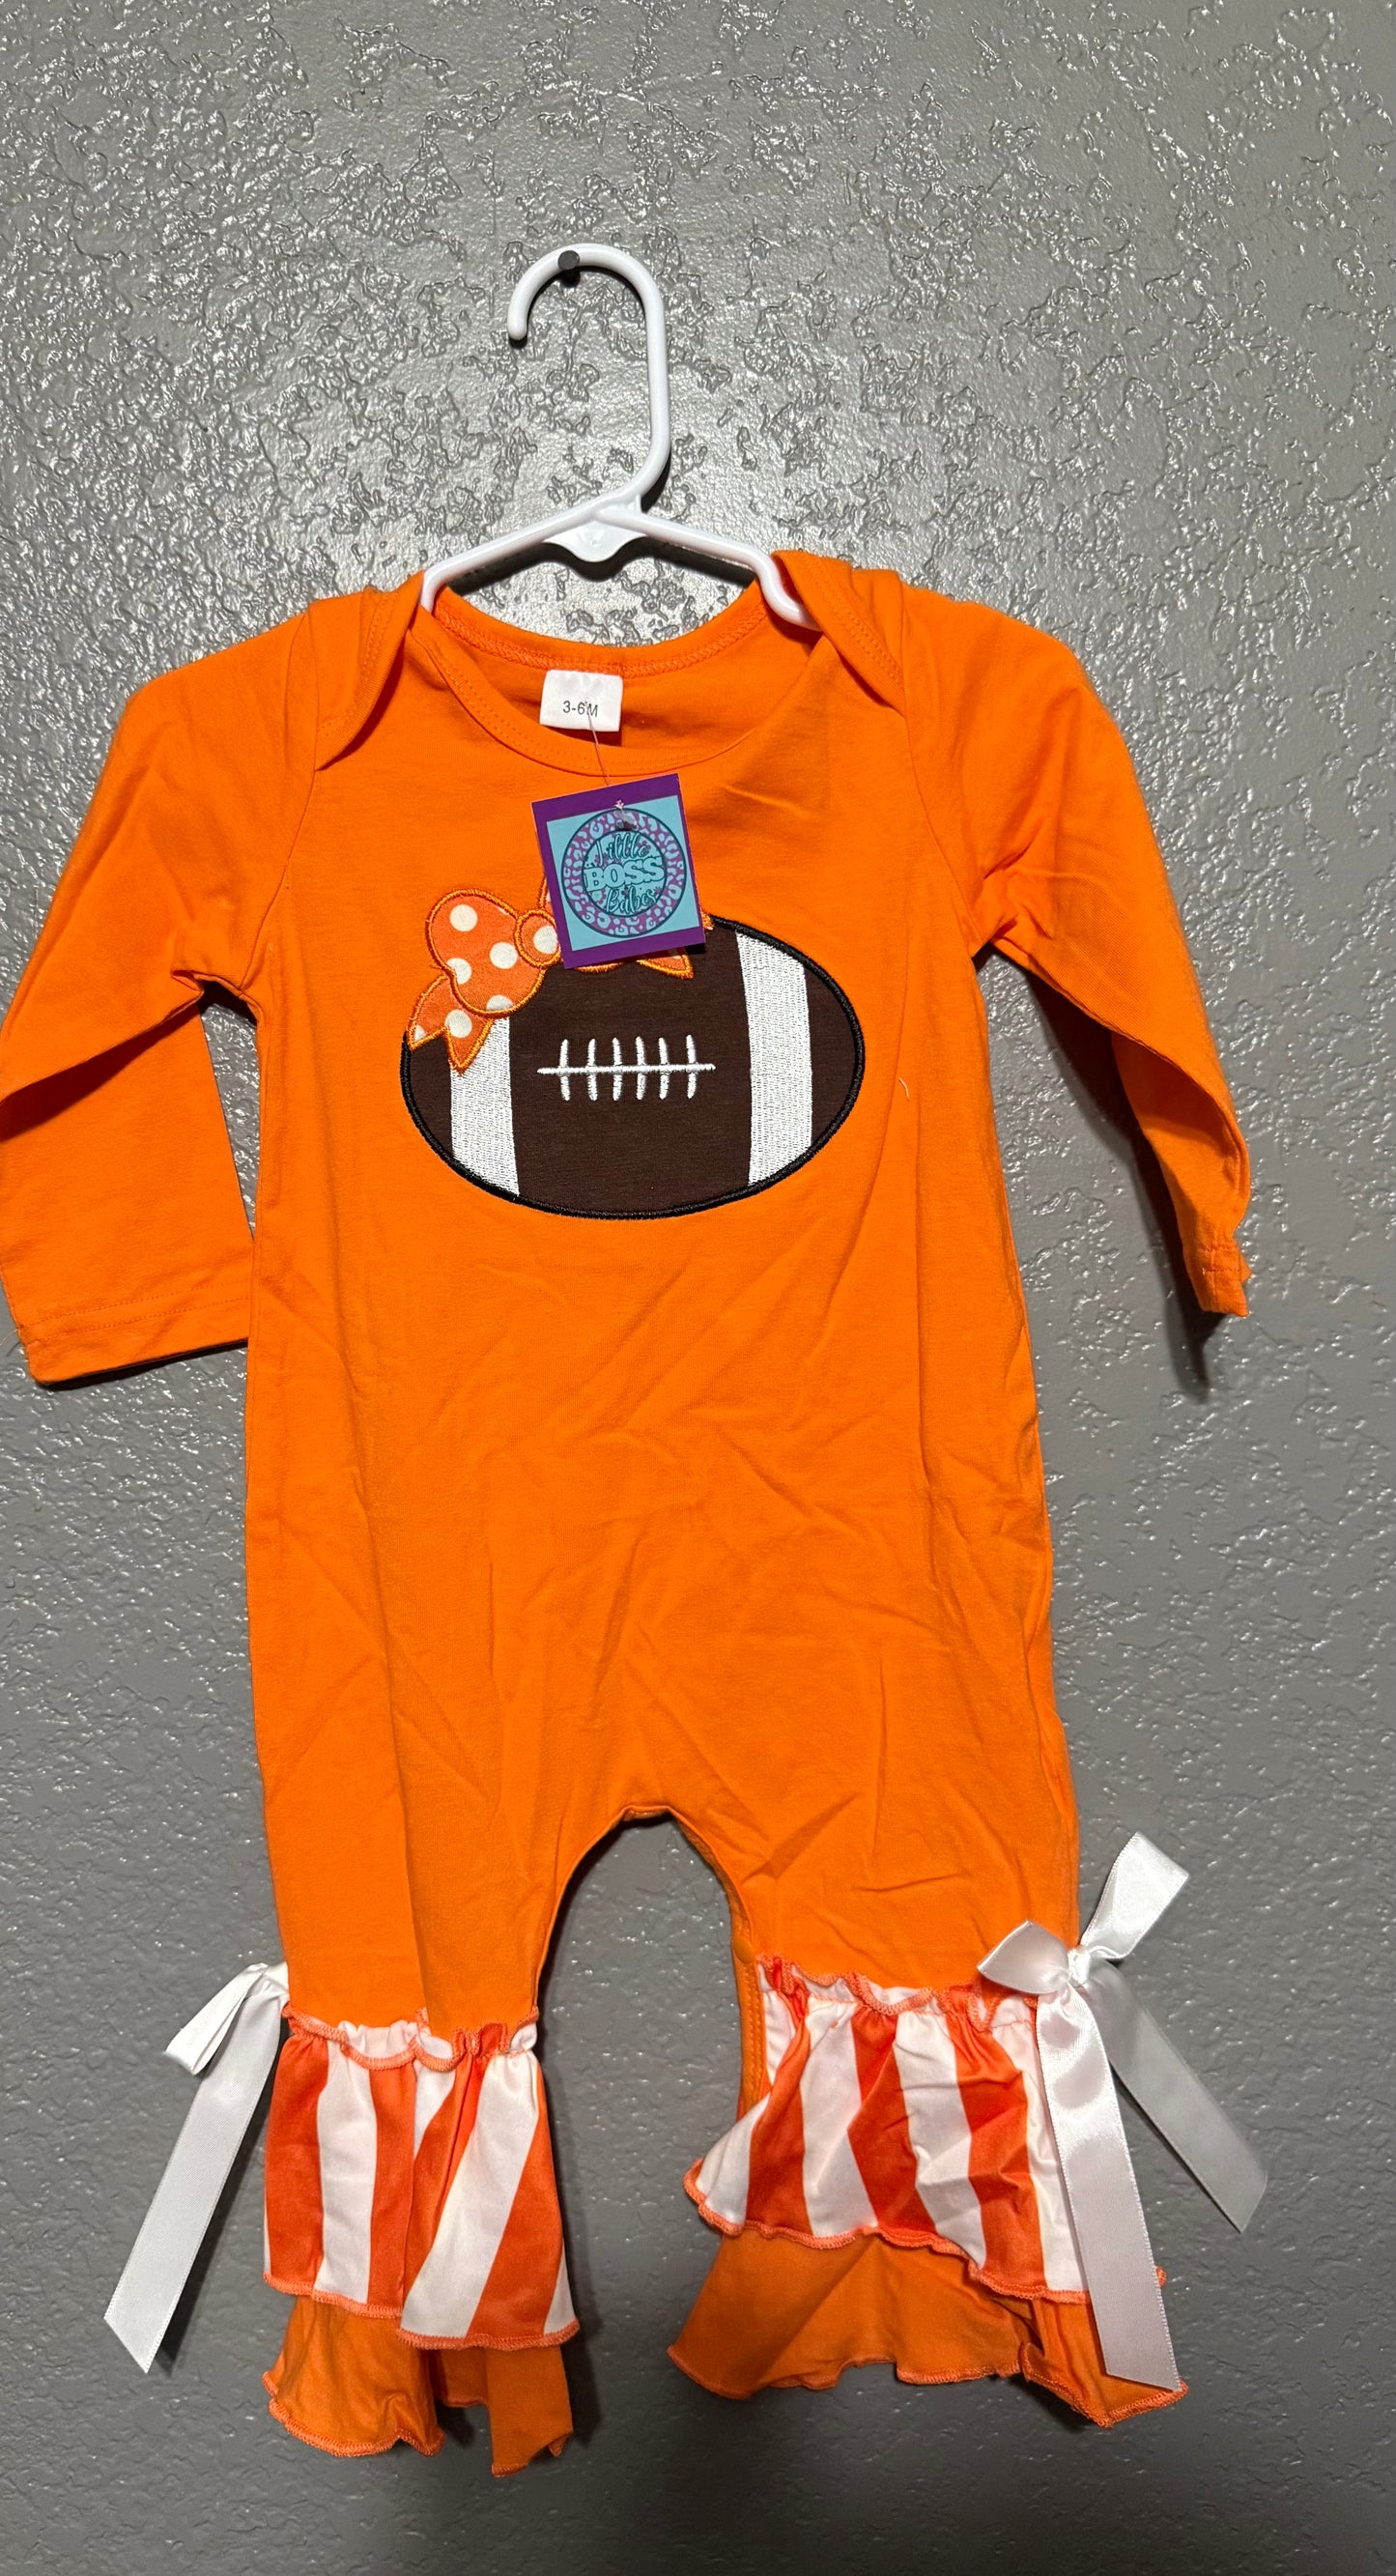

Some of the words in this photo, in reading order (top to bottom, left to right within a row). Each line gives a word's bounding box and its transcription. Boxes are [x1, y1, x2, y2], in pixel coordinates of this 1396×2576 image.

[562, 700, 599, 718] 3-6M
[595, 833, 650, 867] Little
[584, 856, 665, 892] BOSS
[606, 886, 657, 914] Babes
